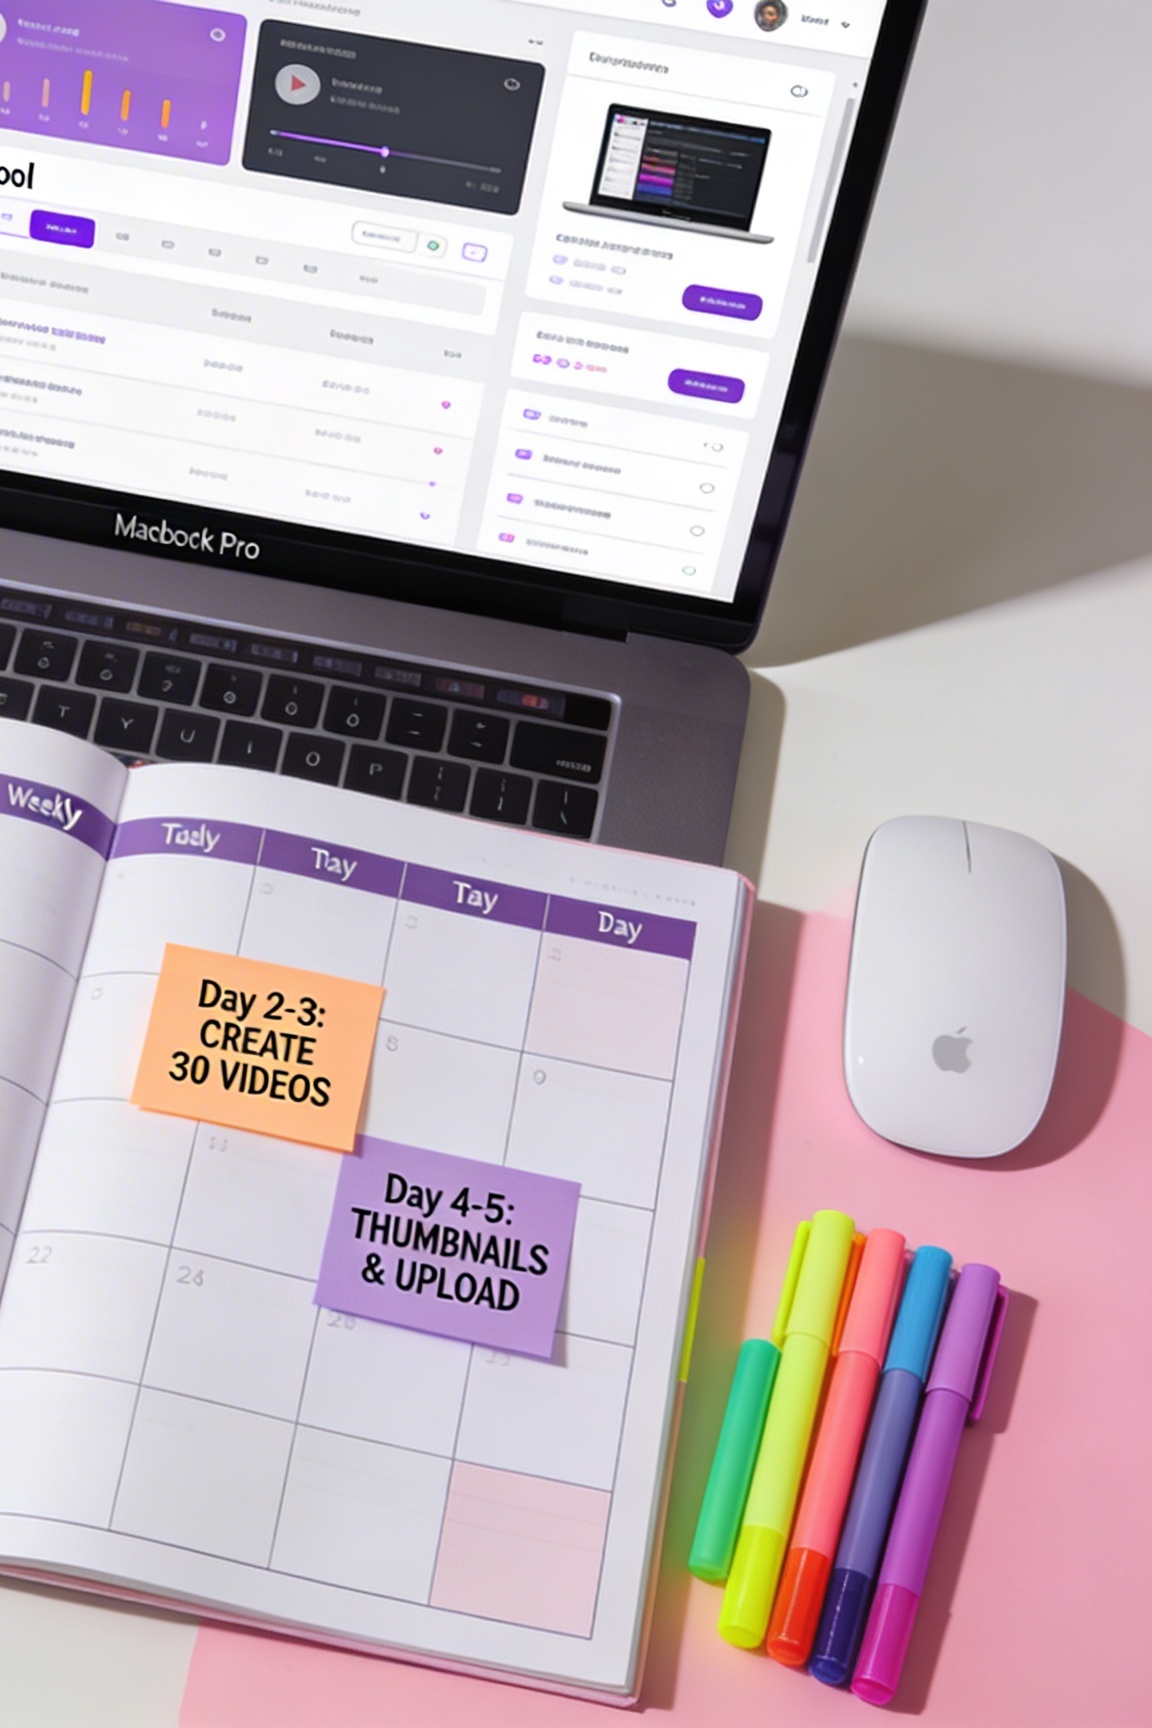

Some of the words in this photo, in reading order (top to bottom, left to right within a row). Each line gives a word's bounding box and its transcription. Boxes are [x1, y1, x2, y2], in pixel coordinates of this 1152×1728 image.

[219, 531, 260, 560] Pro
[180, 728, 196, 743] U
[598, 911, 643, 944] Day
[198, 978, 257, 1022] Day
[263, 991, 326, 1028] 2-3:
[200, 1018, 317, 1066] CREATE
[168, 1050, 210, 1085] 30
[220, 1058, 332, 1108] VIDEOS
[384, 1172, 443, 1218] Day
[449, 1187, 515, 1226] 4-5:
[351, 1206, 550, 1276] THUMBNAILS
[361, 1252, 385, 1285] &
[395, 1257, 520, 1312] UPLOAD
